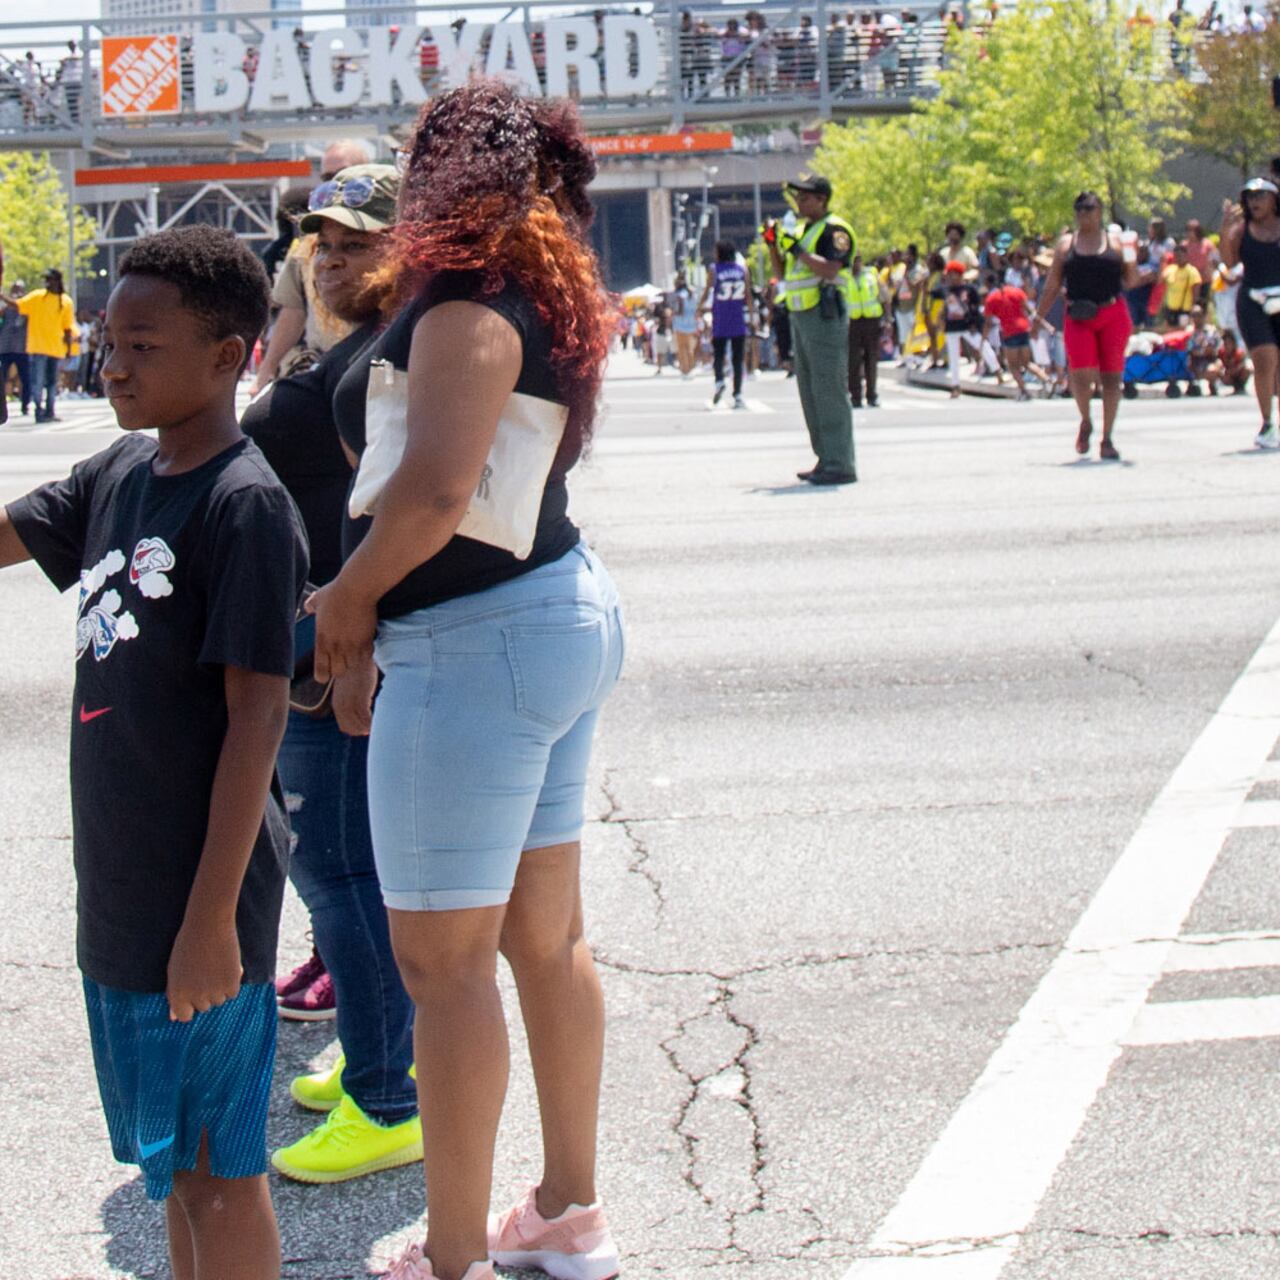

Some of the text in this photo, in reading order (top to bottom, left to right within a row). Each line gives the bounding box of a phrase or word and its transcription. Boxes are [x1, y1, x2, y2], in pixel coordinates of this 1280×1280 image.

[101, 36, 178, 112] HOME
[108, 44, 140, 77] THE
[194, 14, 659, 113] BACKYARD
[133, 63, 178, 112] DEPOT
[717, 280, 746, 300] 32
